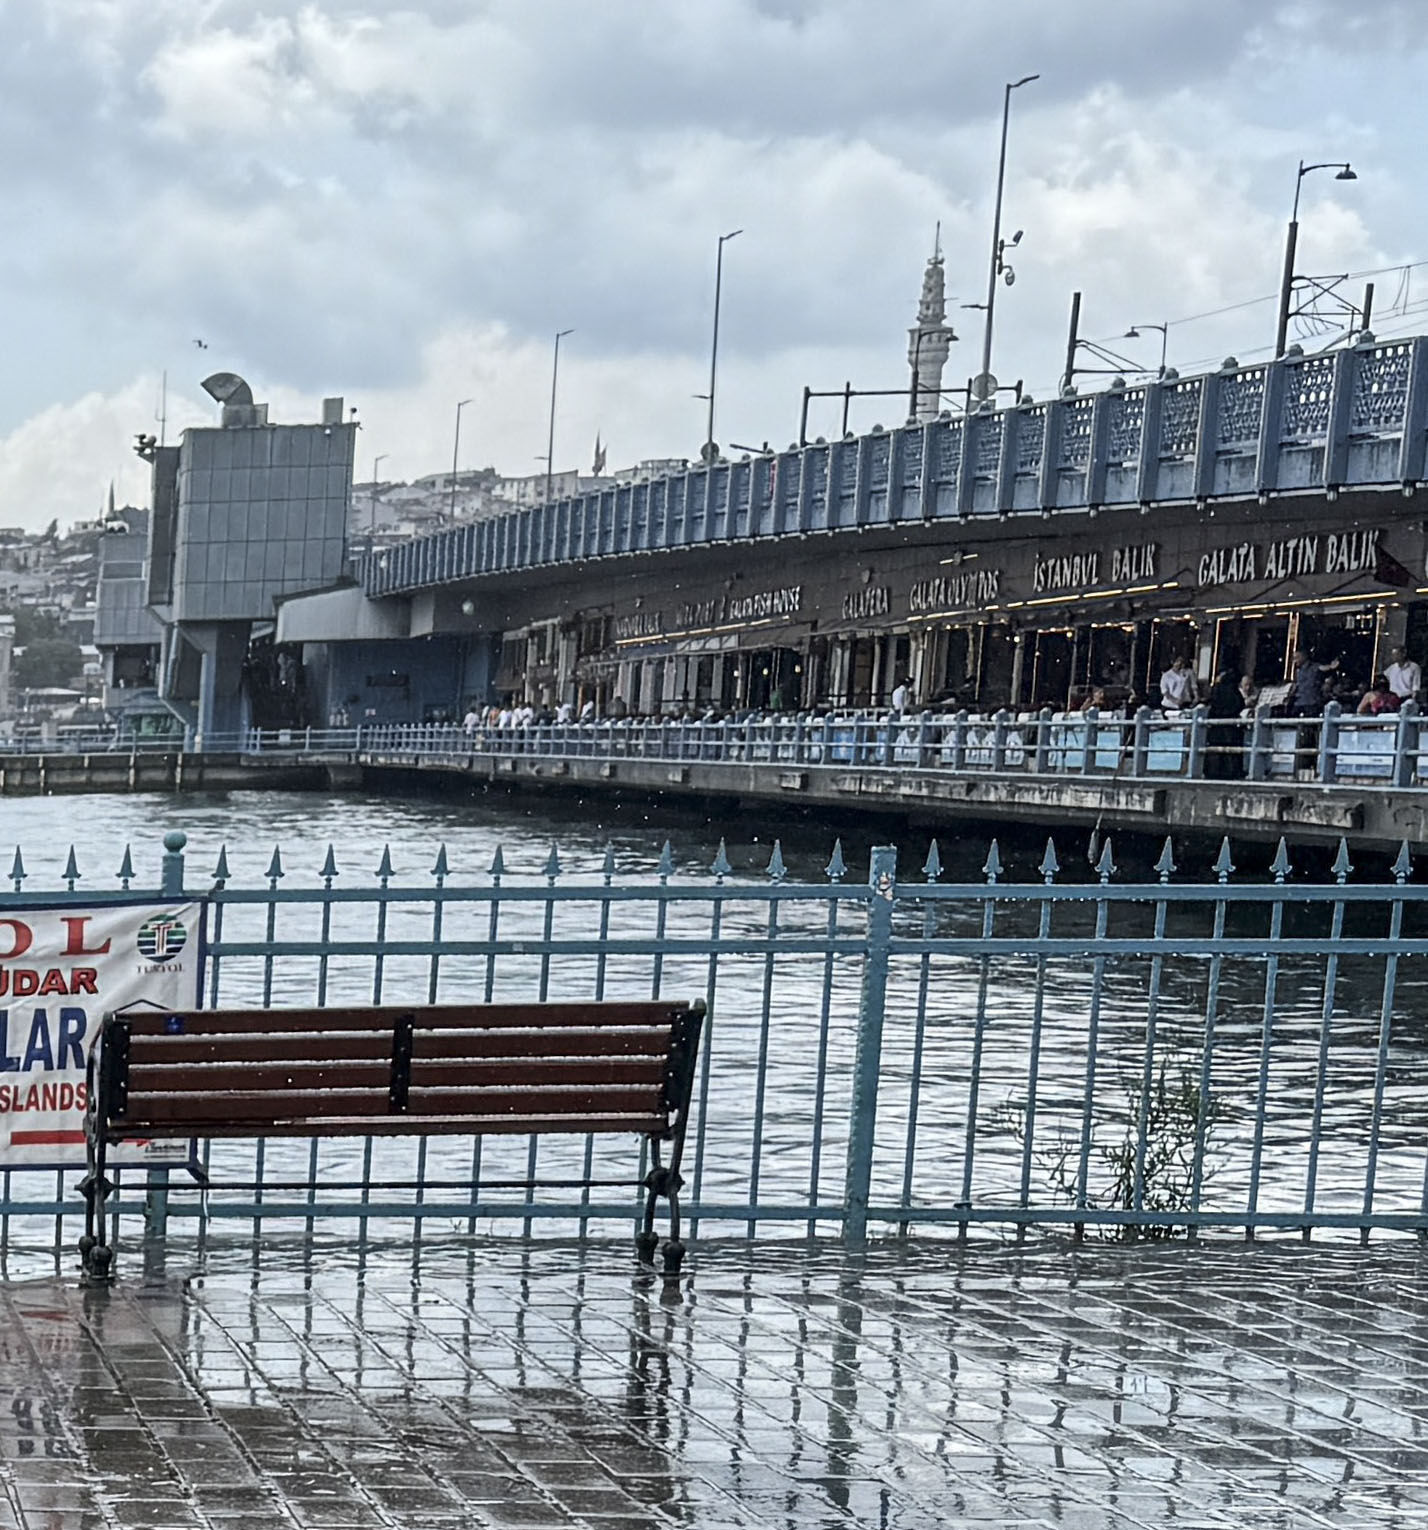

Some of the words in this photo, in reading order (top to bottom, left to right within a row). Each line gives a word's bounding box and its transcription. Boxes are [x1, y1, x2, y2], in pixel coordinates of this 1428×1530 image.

[1112, 544, 1155, 582] BALIK
[1199, 543, 1255, 586] GALATA
[1264, 536, 1317, 579] ALTIN
[1326, 530, 1378, 573] BALIK
